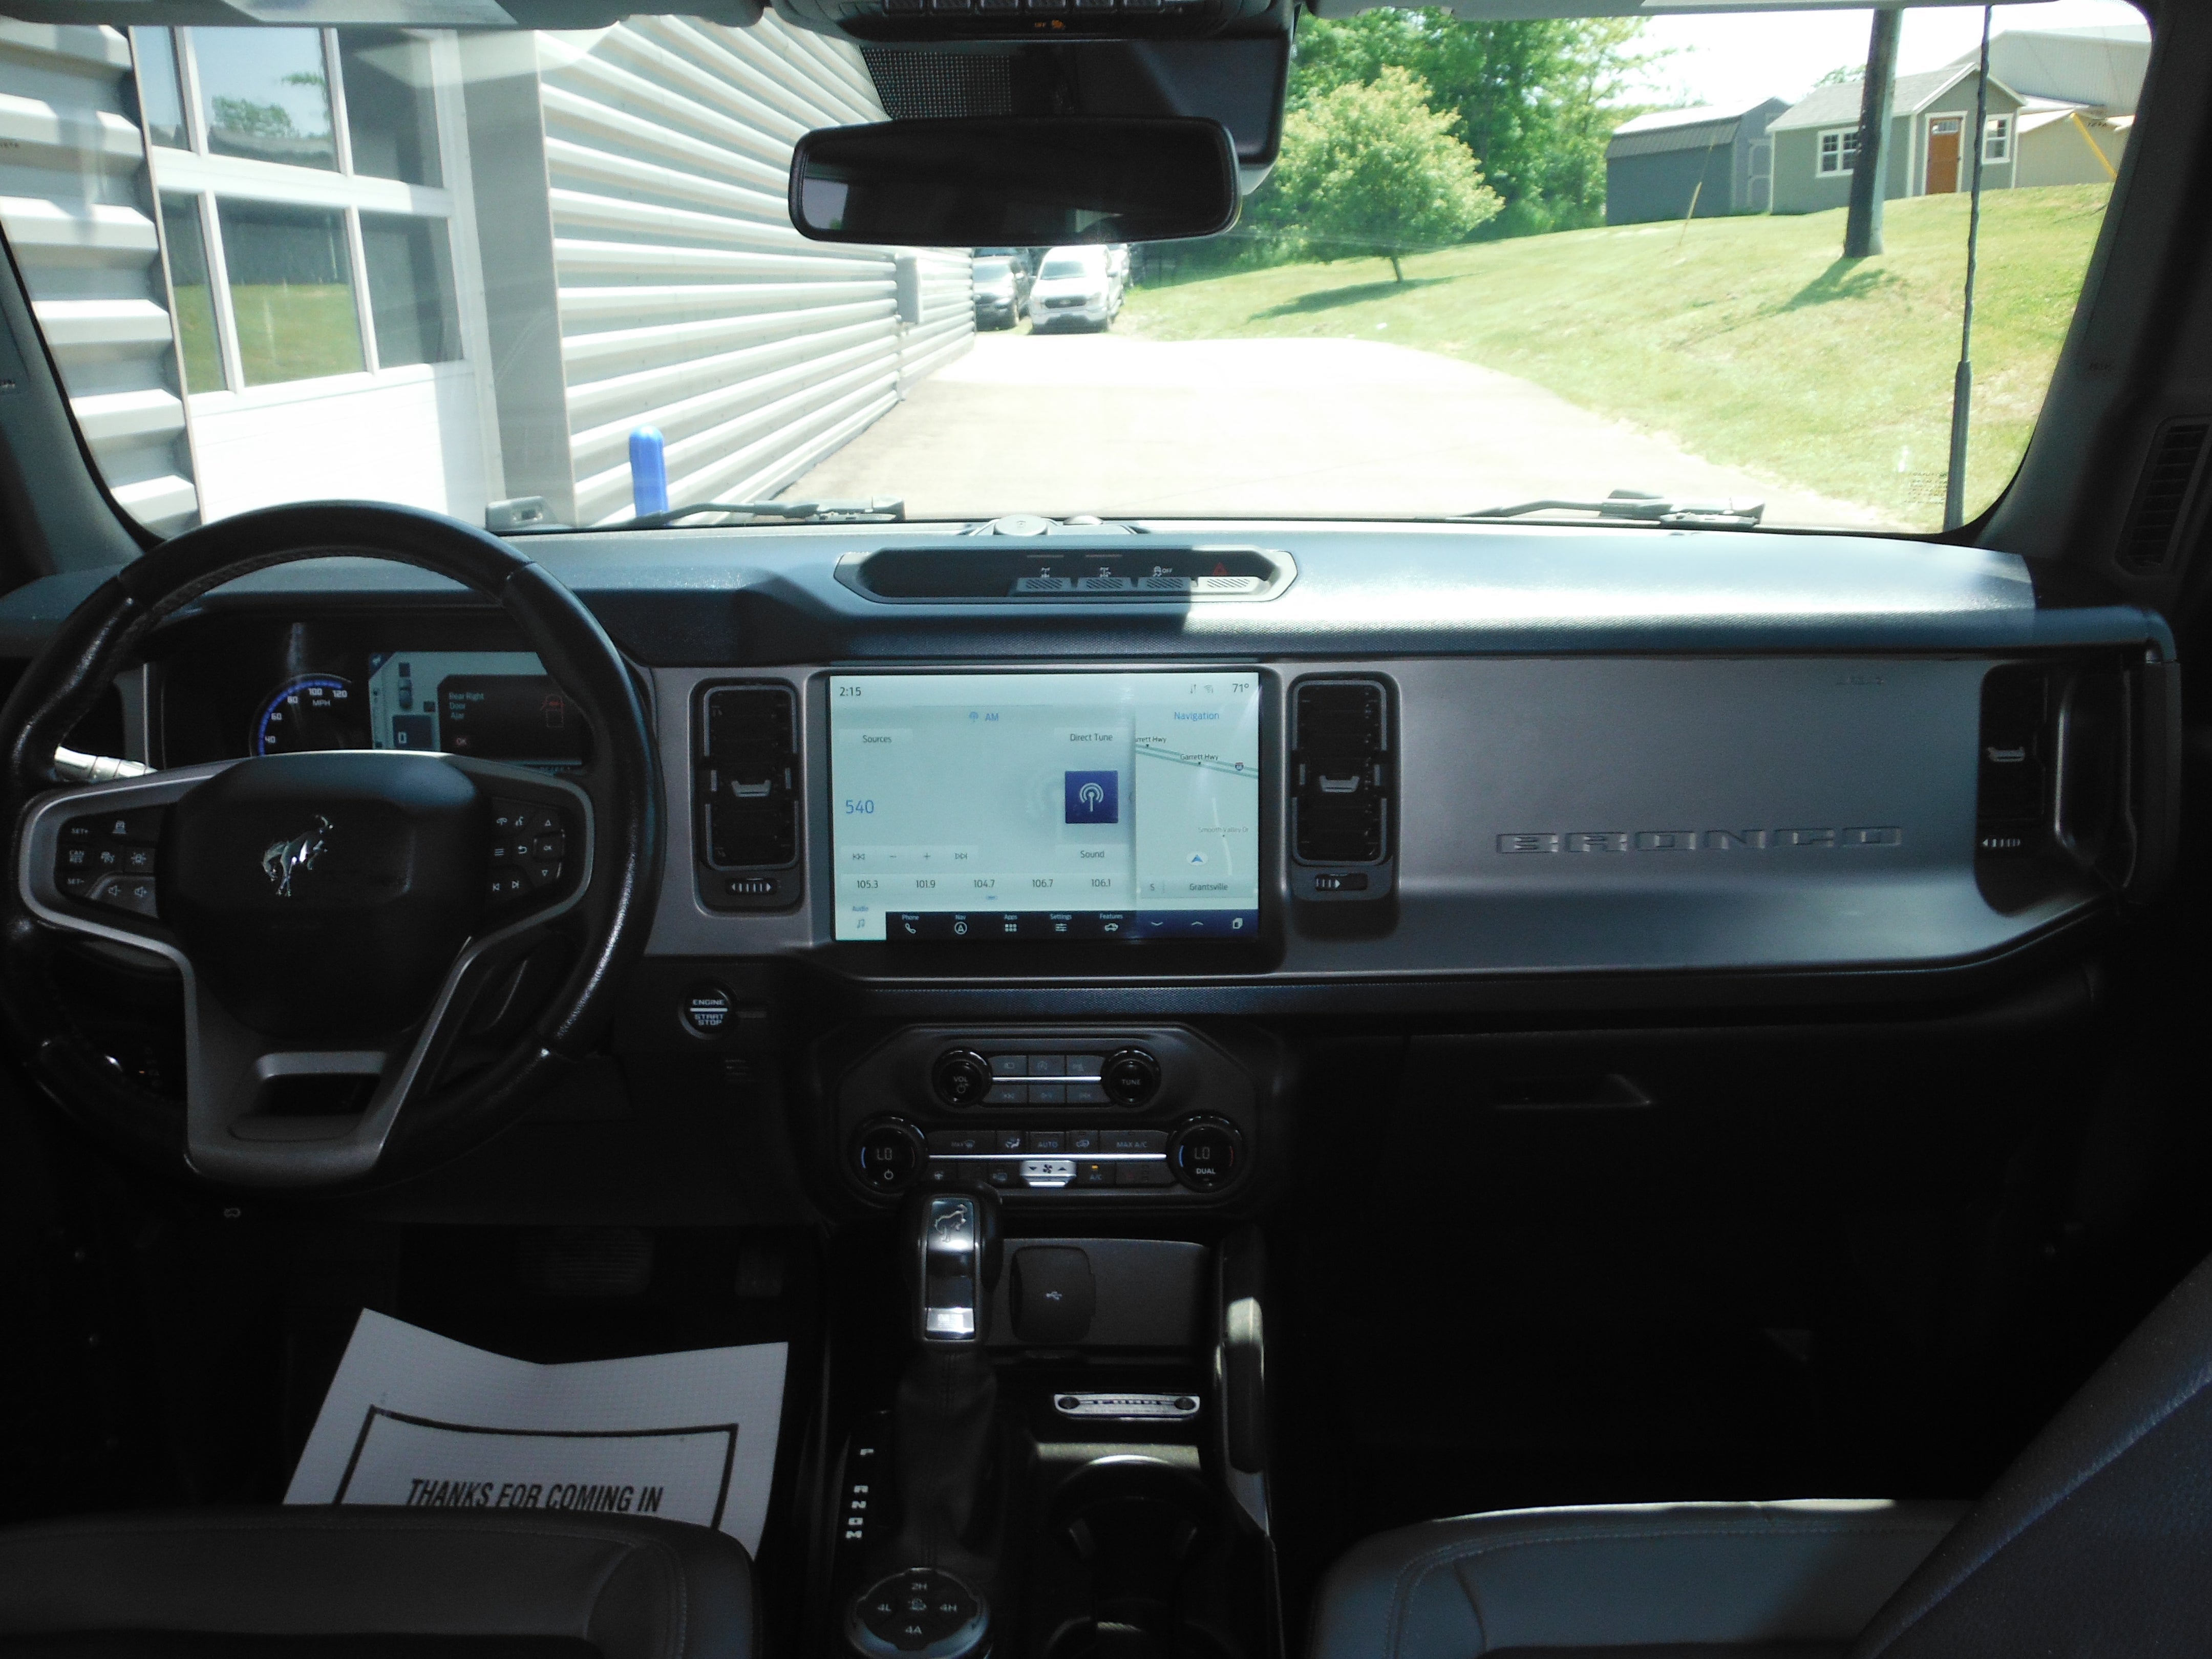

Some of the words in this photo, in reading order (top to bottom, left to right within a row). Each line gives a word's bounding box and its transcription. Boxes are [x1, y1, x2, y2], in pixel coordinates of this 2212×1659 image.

[839, 687, 861, 696] 2:15
[1232, 683, 1249, 692] 71°
[985, 713, 998, 721] AM
[1174, 711, 1219, 721] Navigation
[1094, 733, 1113, 741] Tune
[846, 800, 874, 813] 540
[1496, 826, 1901, 853] BRONCO
[857, 880, 878, 888] 105.3
[916, 879, 935, 888] 101.9
[974, 879, 995, 887] 104.7
[1032, 879, 1053, 887] 106.7
[1091, 879, 1111, 887] 106.1
[408, 1478, 493, 1506] THANKS
[495, 1483, 542, 1507] FOR
[545, 1483, 633, 1511] COMING
[637, 1486, 663, 1512] IN
[877, 1603, 891, 1612] 4L
[940, 1603, 958, 1612] 4H
[905, 1625, 922, 1634] 4A
